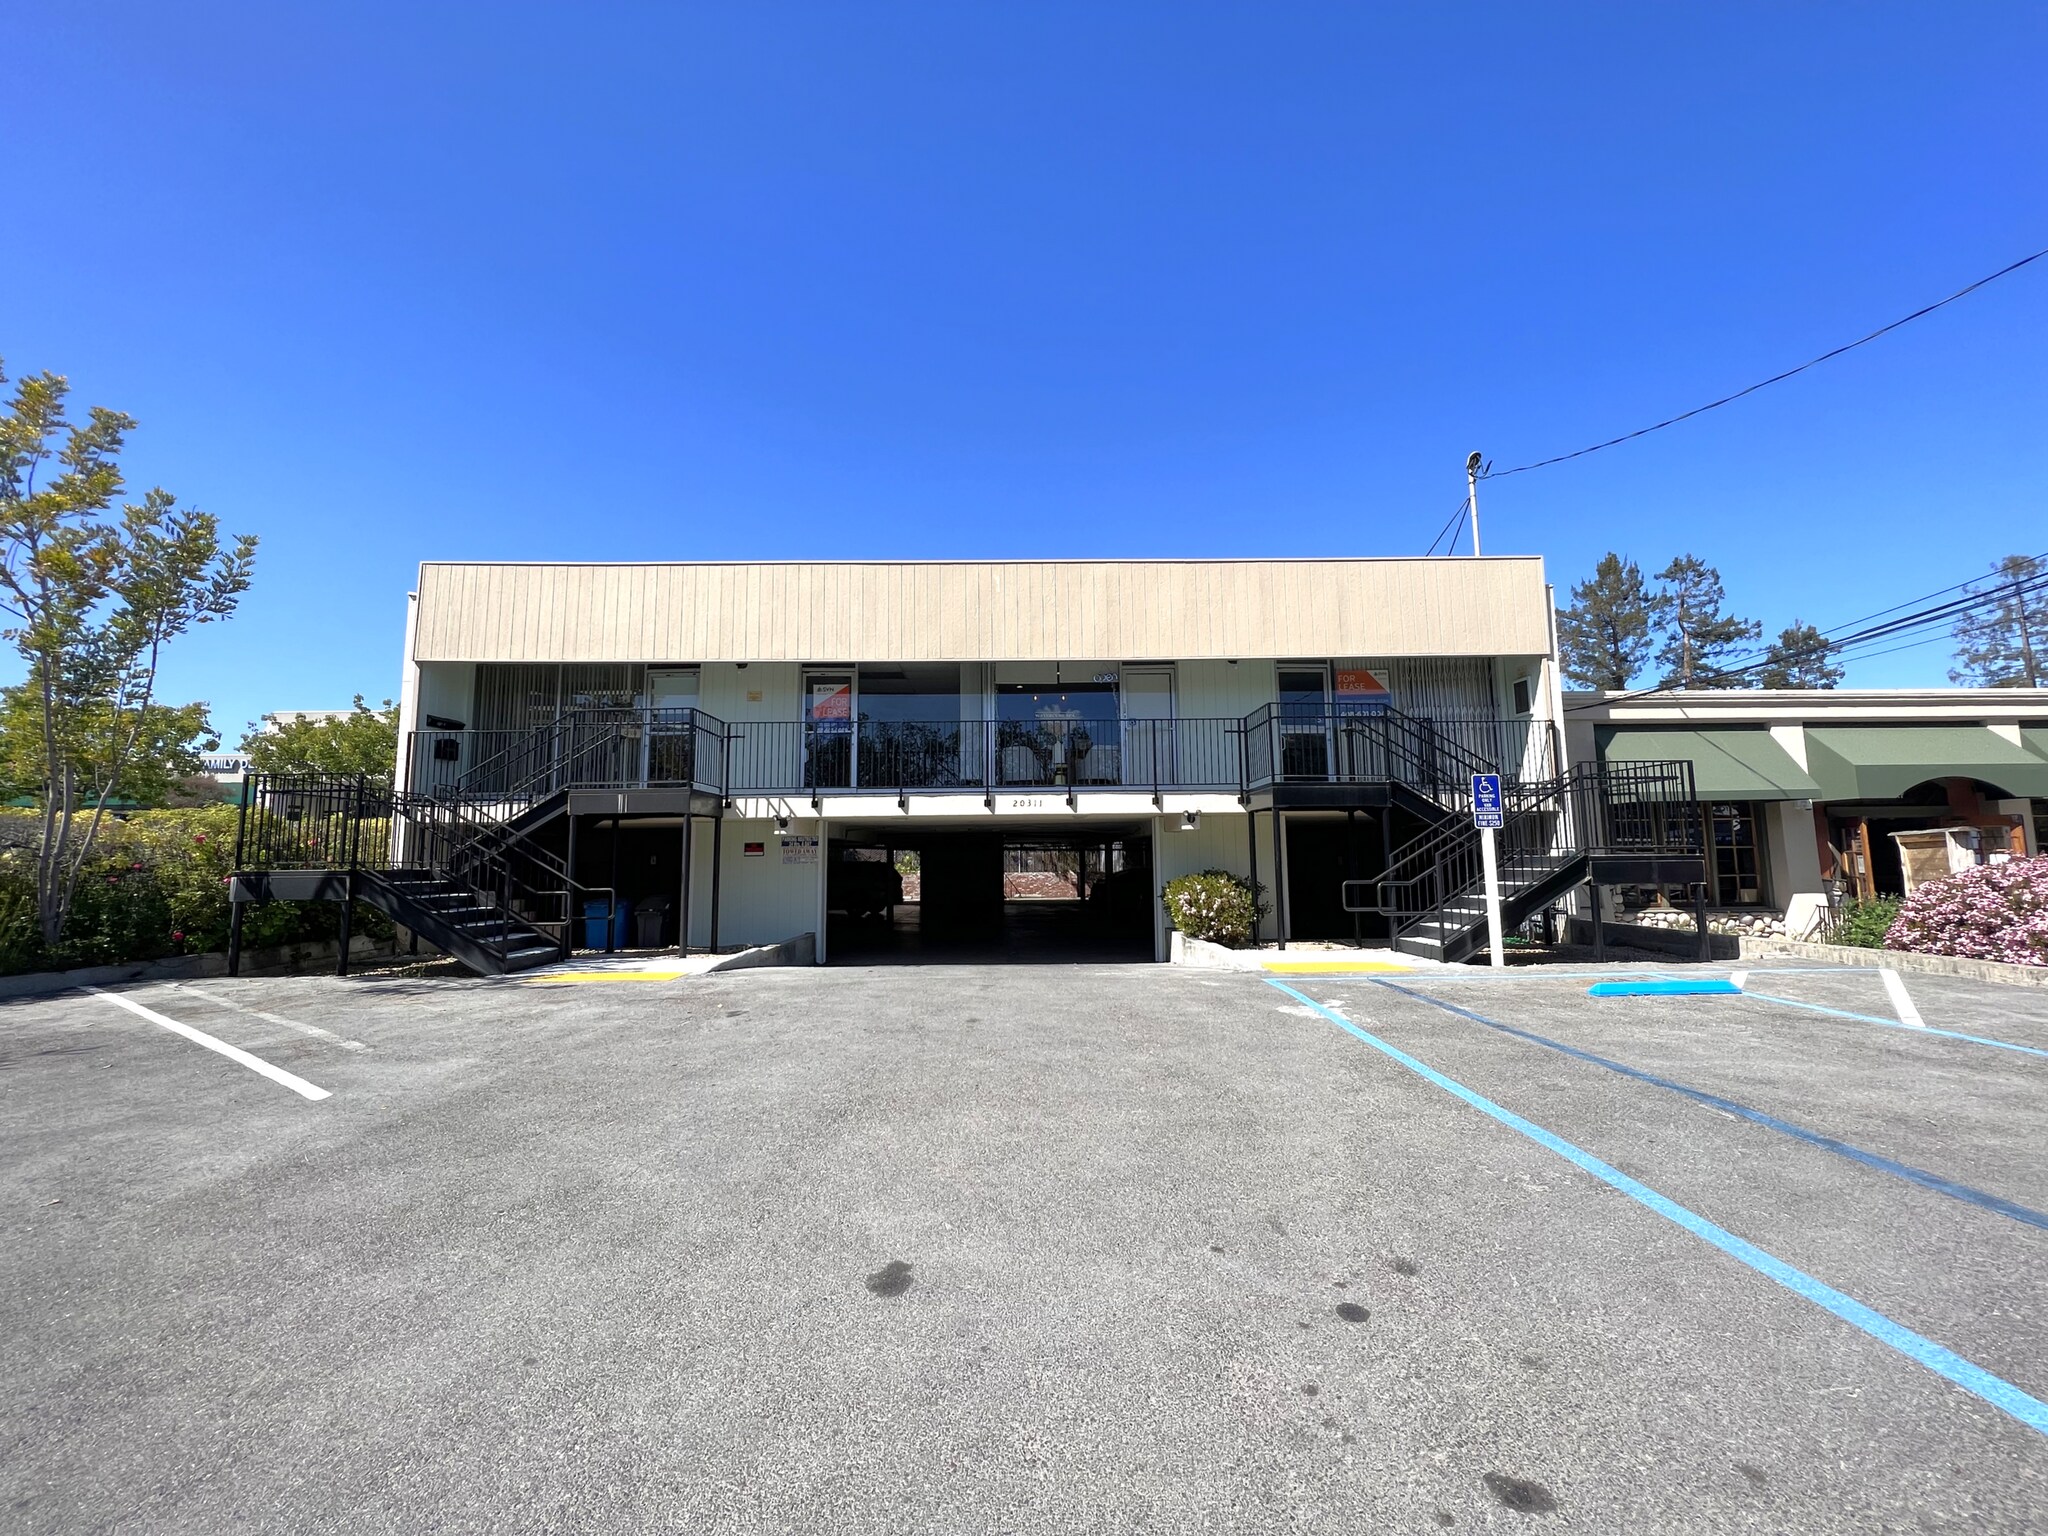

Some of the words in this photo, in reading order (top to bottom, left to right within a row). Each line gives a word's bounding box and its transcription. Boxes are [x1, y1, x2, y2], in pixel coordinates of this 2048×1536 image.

[1338, 674, 1356, 682] FOR
[1338, 682, 1366, 691] LEASE
[831, 697, 848, 706] FOR
[822, 707, 848, 718] LEASE
[1012, 798, 1043, 808] 20311
